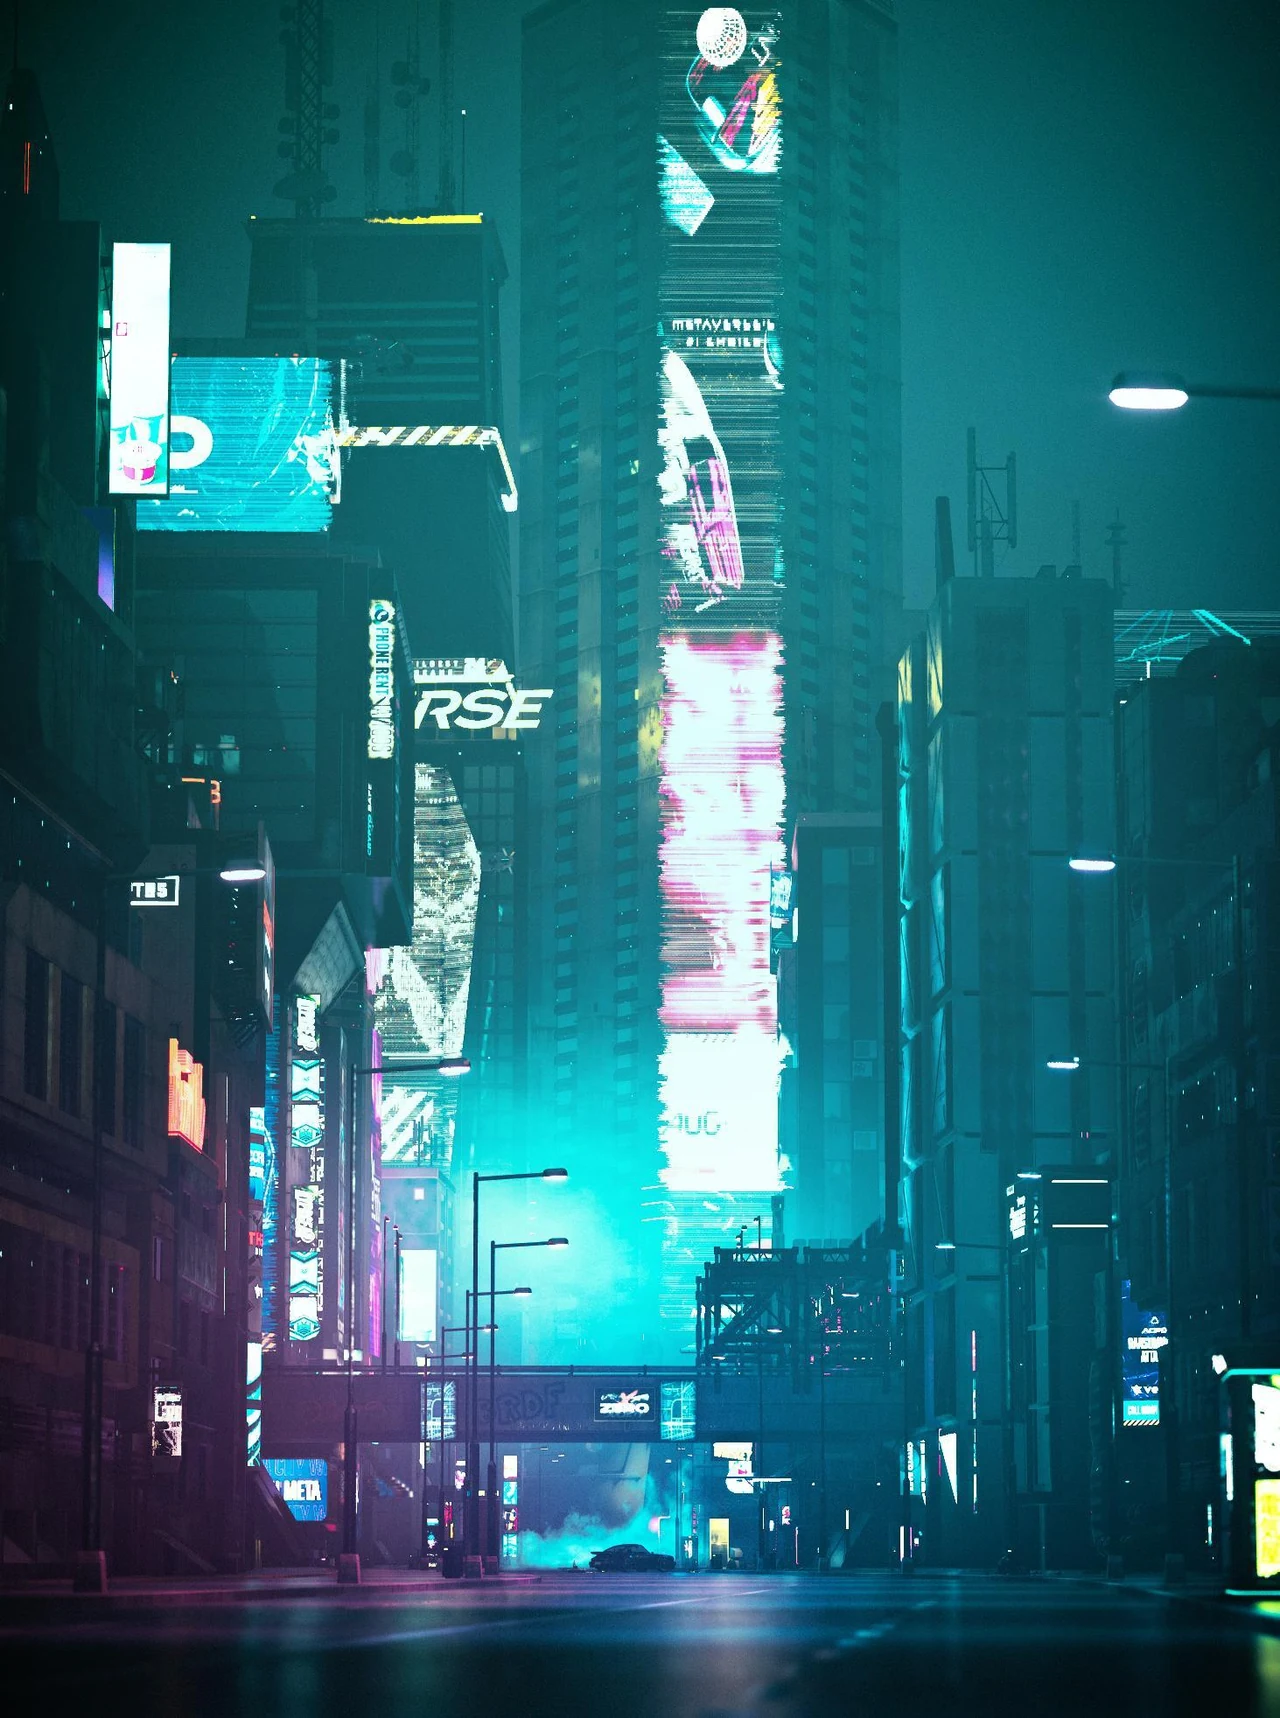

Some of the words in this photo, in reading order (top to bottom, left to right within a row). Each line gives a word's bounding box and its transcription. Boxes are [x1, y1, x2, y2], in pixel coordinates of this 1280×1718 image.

[375, 627, 390, 664] PHONE
[375, 667, 390, 695] RENT
[283, 1480, 322, 1501] META
